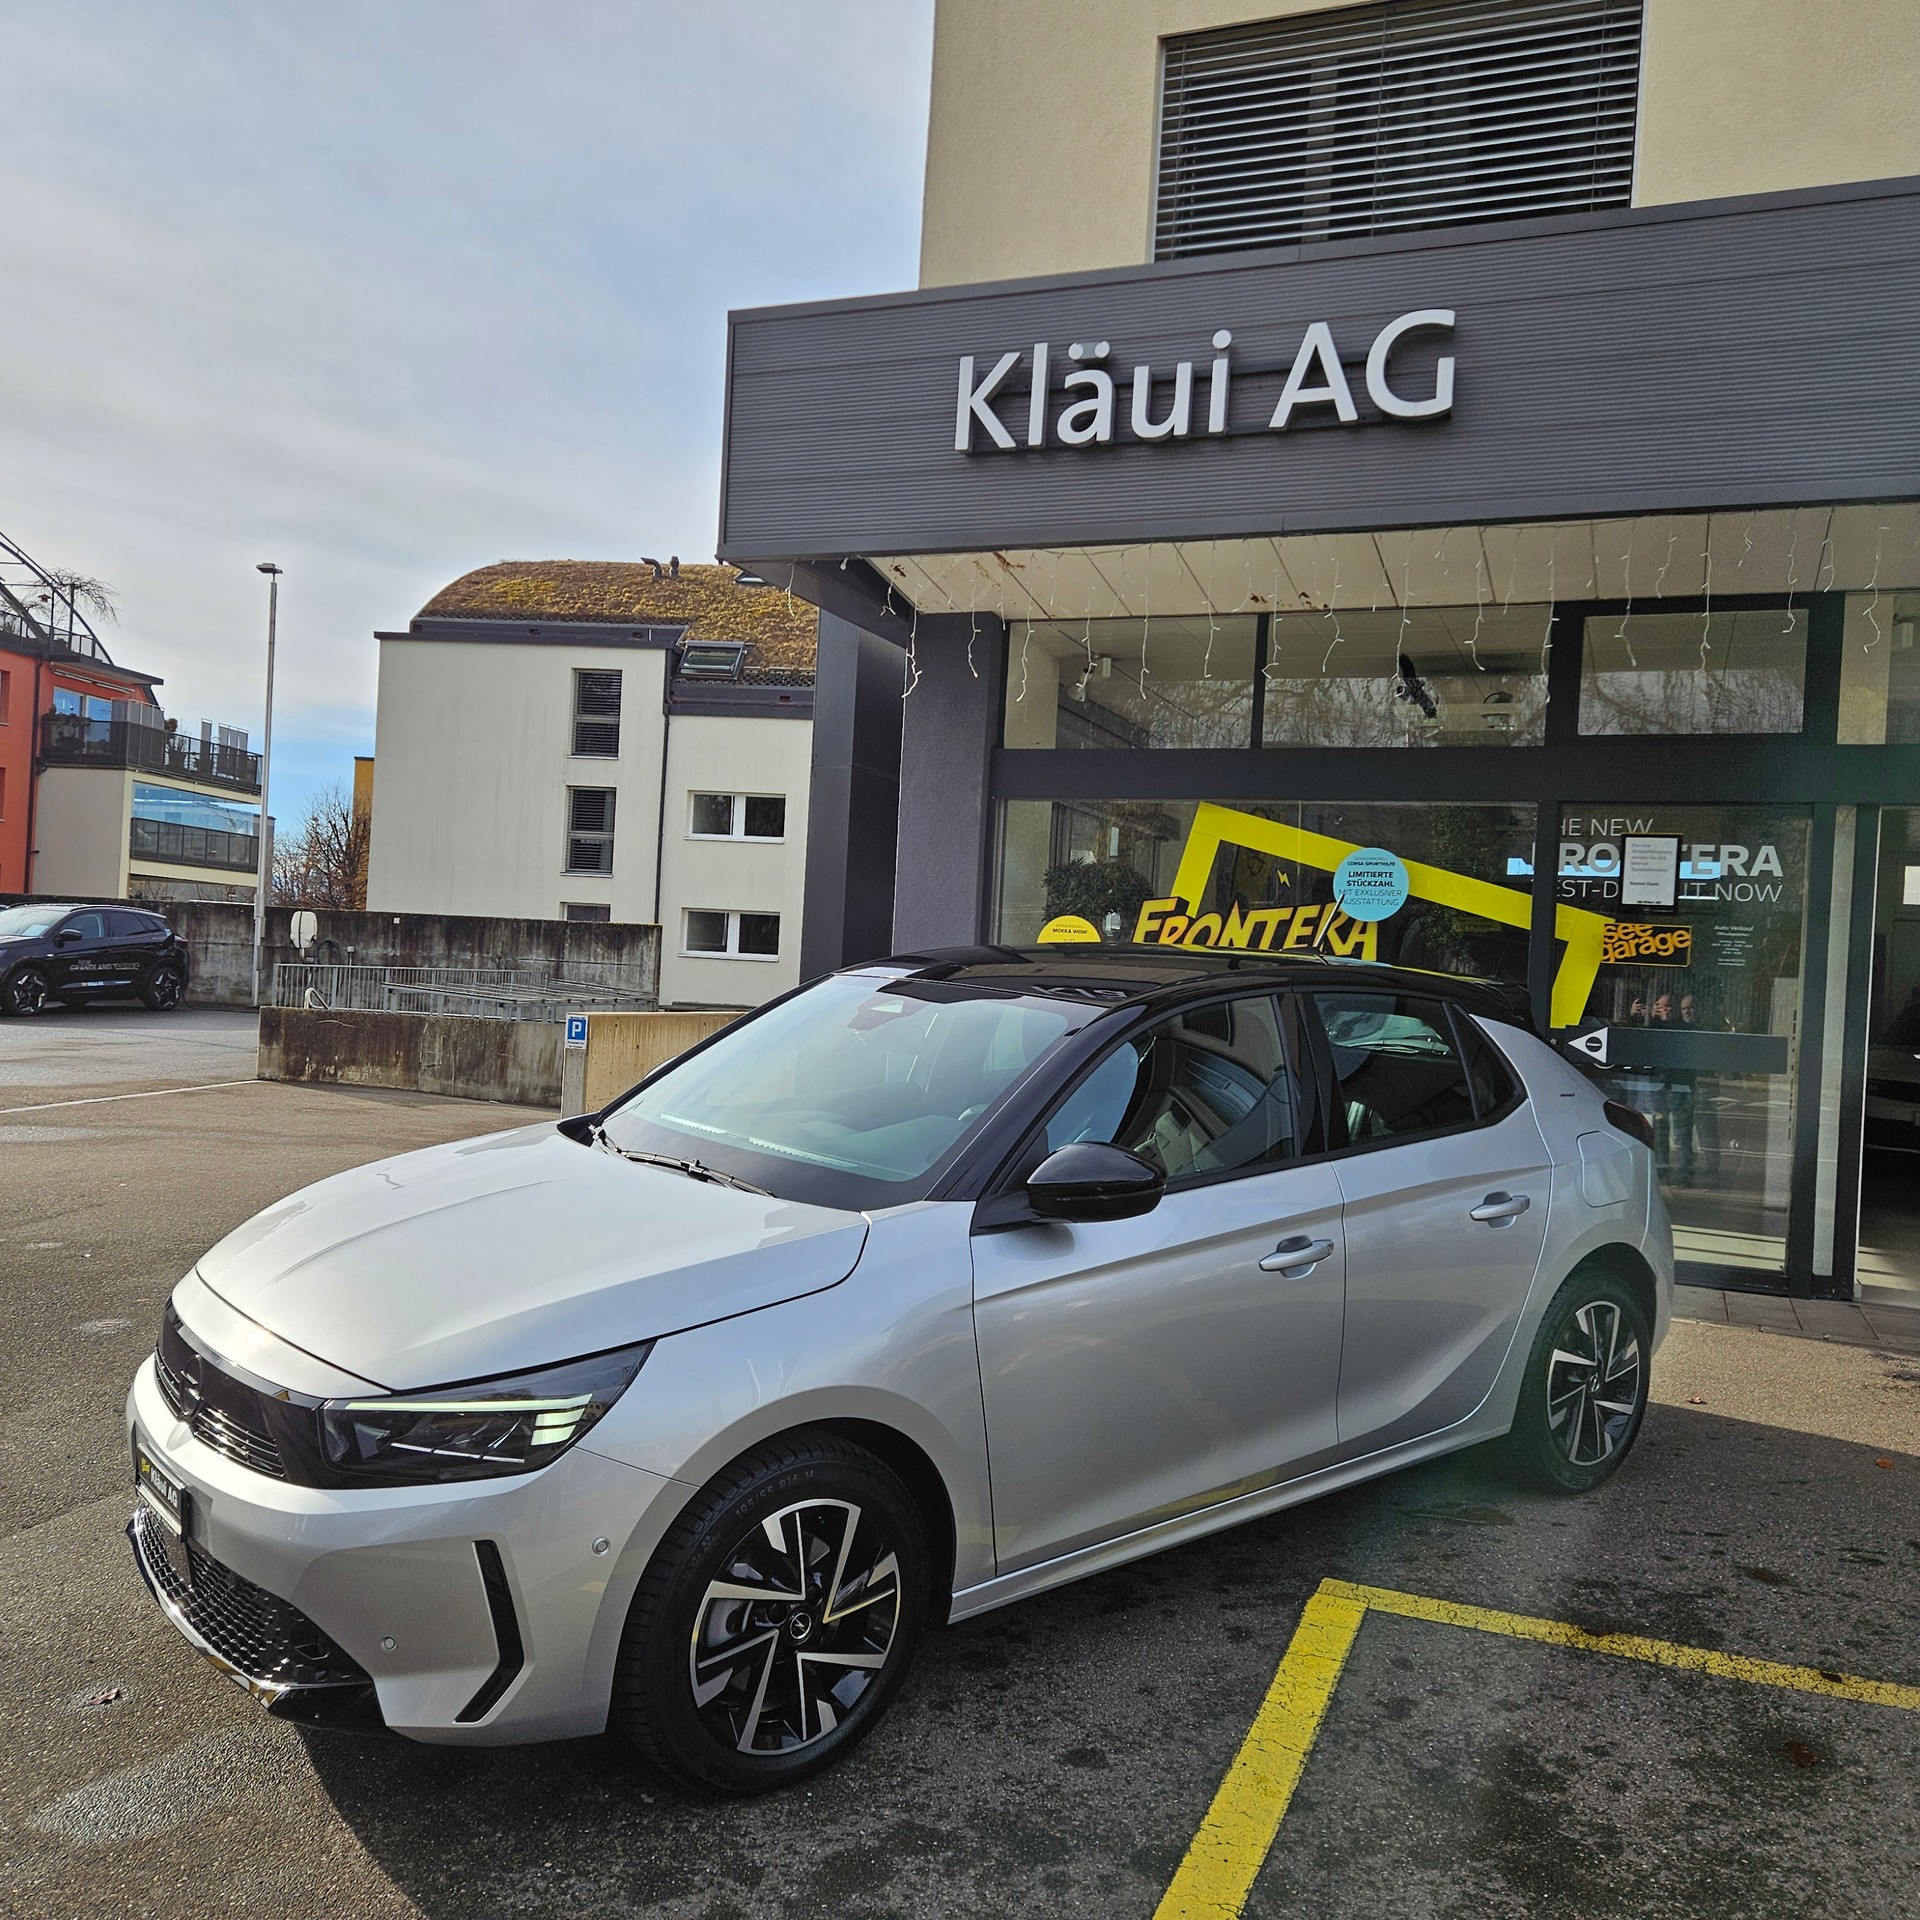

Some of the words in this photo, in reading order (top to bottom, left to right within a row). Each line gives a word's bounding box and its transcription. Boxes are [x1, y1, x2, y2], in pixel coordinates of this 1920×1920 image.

[955, 329, 1233, 454] Kläui
[1269, 308, 1456, 430] AG
[1590, 818, 1653, 837] NEW
[1346, 879, 1395, 887] STÜCKZAHL
[1715, 883, 1783, 902] NOW
[1355, 889, 1402, 897] EXKLUSIVER
[1603, 923, 1653, 944] see
[1602, 930, 1692, 963] garage
[572, 1021, 582, 1038] P
[167, 1486, 178, 1508] AG
